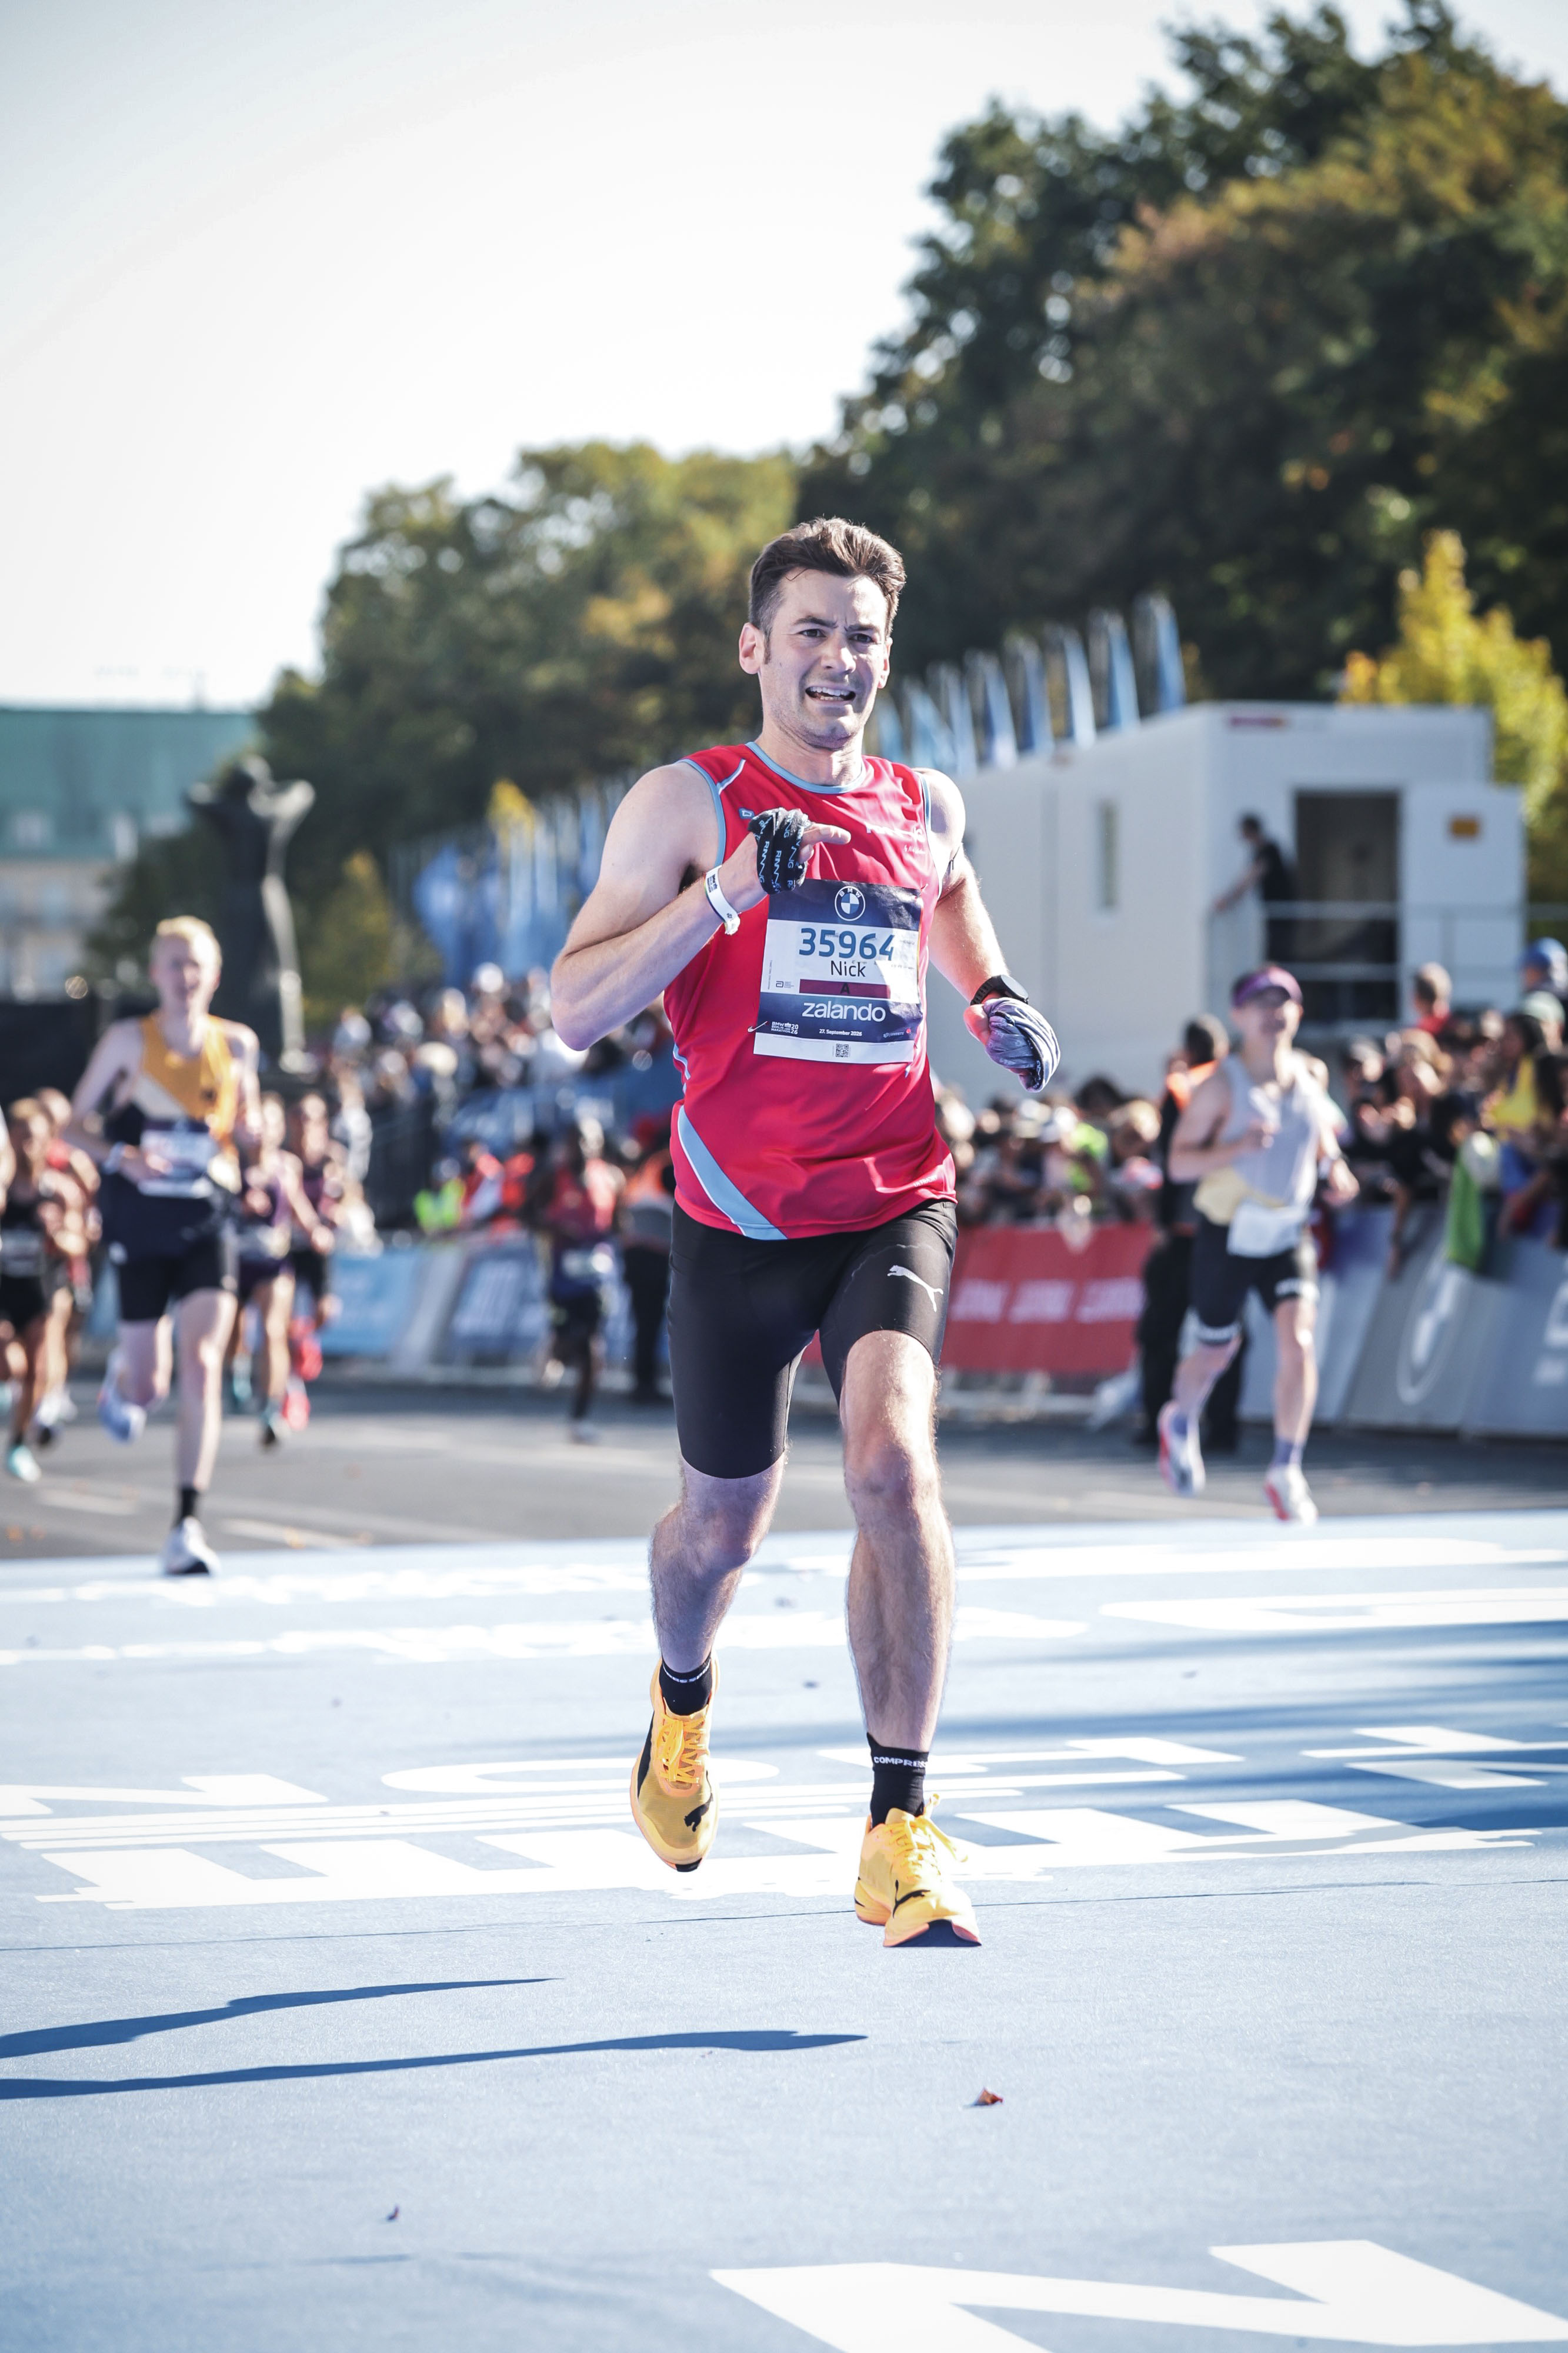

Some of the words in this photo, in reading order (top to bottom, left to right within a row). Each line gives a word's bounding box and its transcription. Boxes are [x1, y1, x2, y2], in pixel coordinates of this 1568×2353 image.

[839, 888, 862, 898] BMW
[799, 928, 895, 961] 35964
[830, 959, 866, 978] Nick
[840, 983, 850, 994] A
[802, 1000, 886, 1022] zalando
[873, 1757, 926, 1768] COMPRES
